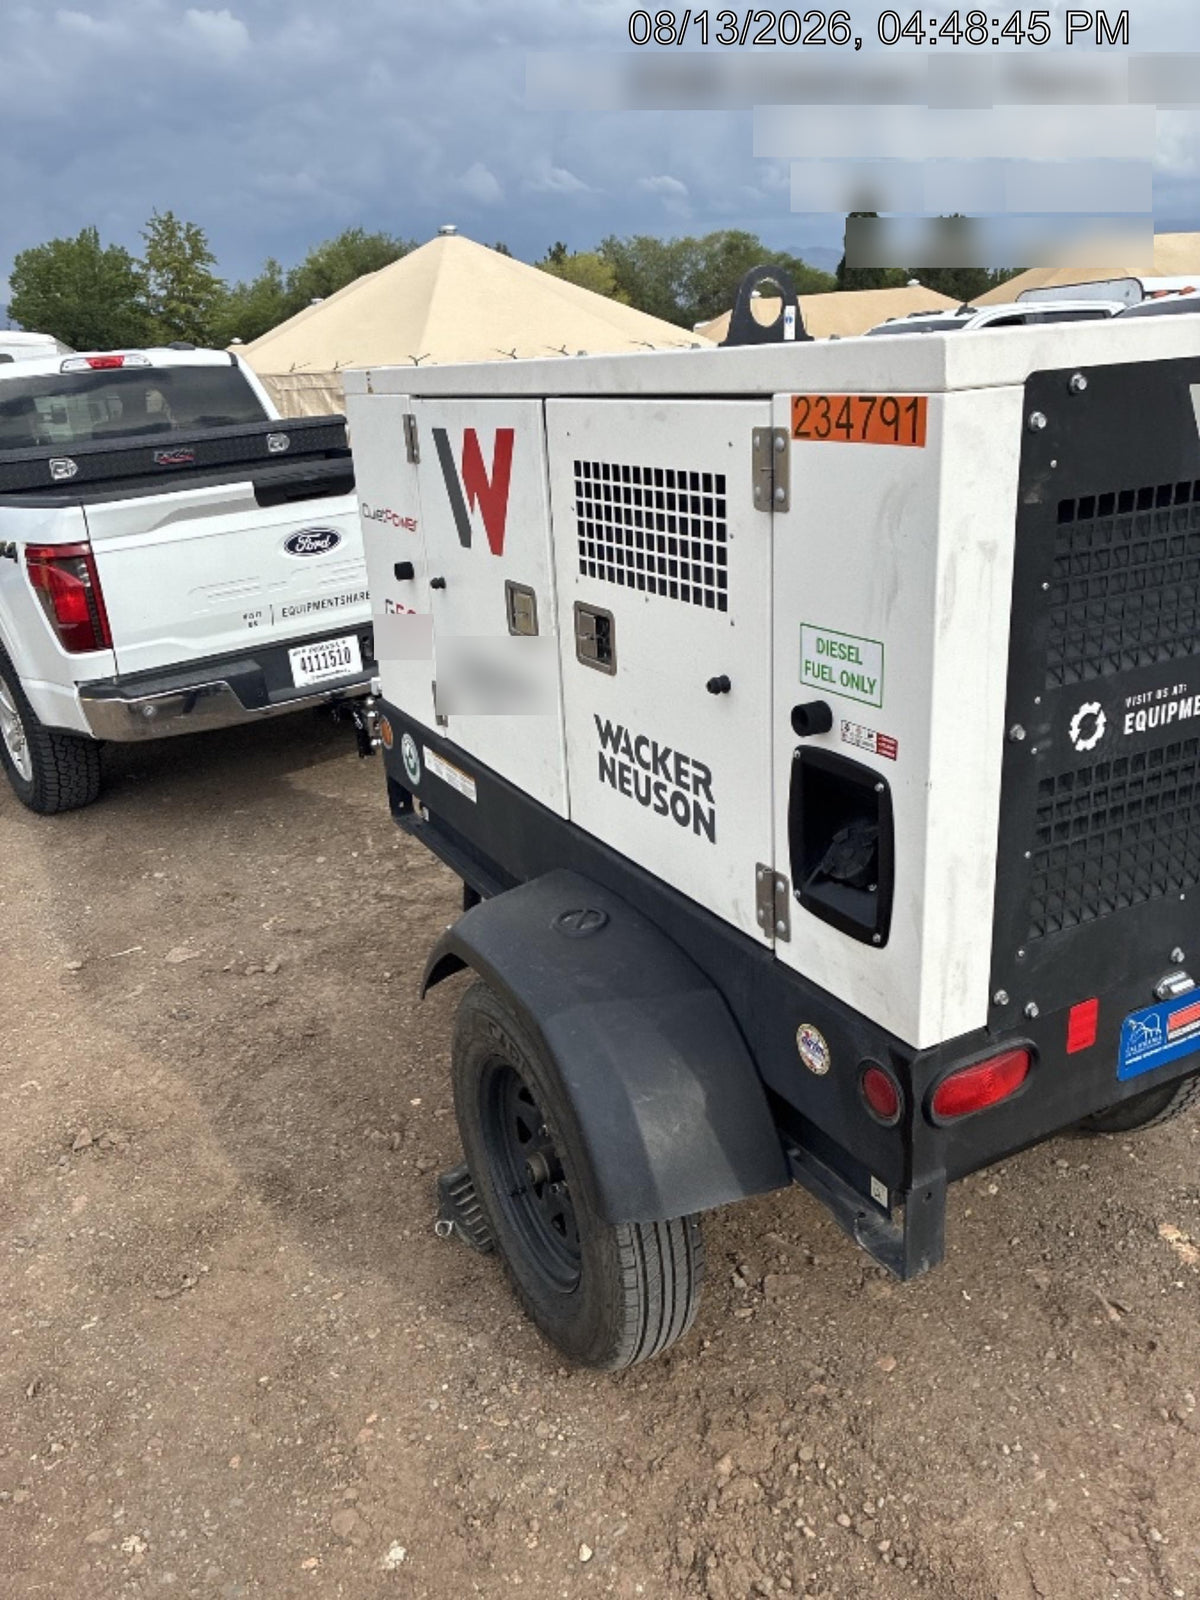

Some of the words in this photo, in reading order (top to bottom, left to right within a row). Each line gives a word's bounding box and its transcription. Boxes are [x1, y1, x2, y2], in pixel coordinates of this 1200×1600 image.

[794, 396, 919, 443] 234791
[294, 533, 331, 552] Ford
[281, 590, 371, 618] EQUIPMENTSHARE
[300, 646, 351, 673] 4111510
[816, 637, 863, 666] DIESEL
[804, 659, 836, 683] FUEL
[840, 670, 877, 695] ONLY
[1125, 690, 1153, 708] VISIT
[1155, 687, 1169, 699] US
[1171, 683, 1187, 696] AT:
[594, 713, 715, 804] WACKER
[599, 751, 716, 844] NEUSON
